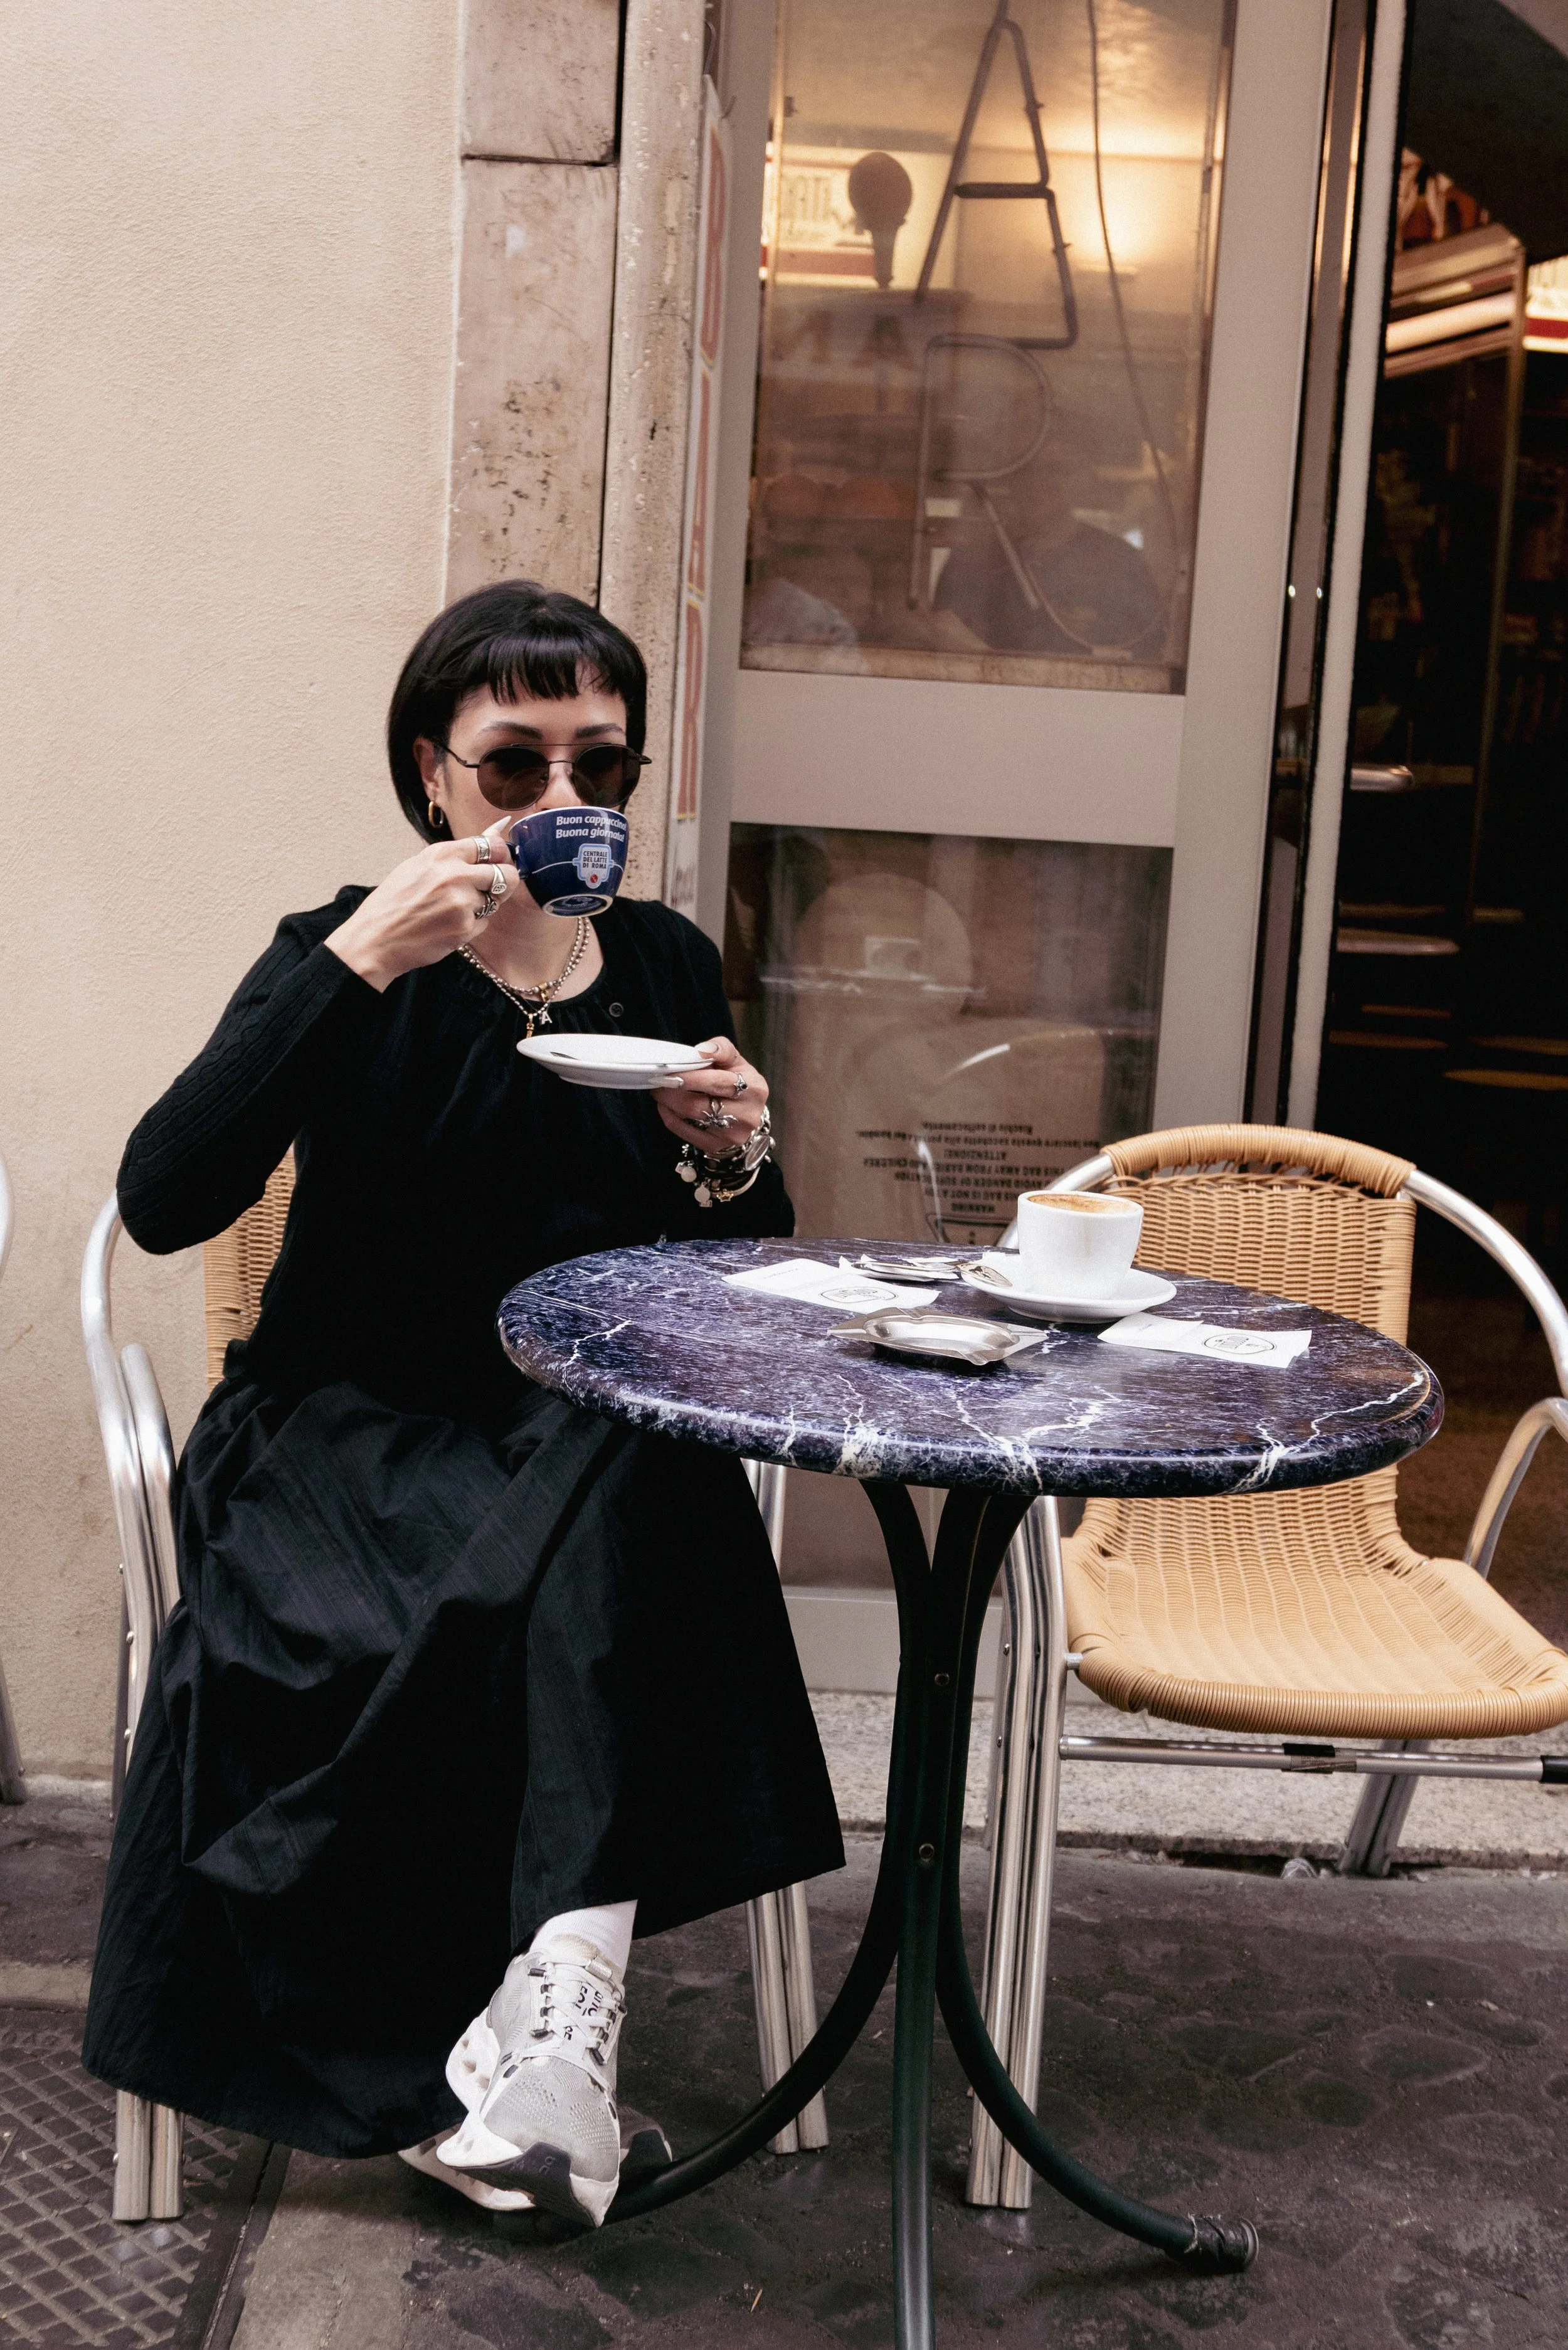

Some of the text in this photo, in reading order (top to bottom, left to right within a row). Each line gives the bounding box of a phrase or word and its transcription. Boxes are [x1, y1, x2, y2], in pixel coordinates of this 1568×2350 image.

[677, 124, 726, 820] BAR
[556, 816, 582, 825] Buon
[556, 828, 625, 842] Buona giornata!
[951, 1204, 995, 1212] WARNING
